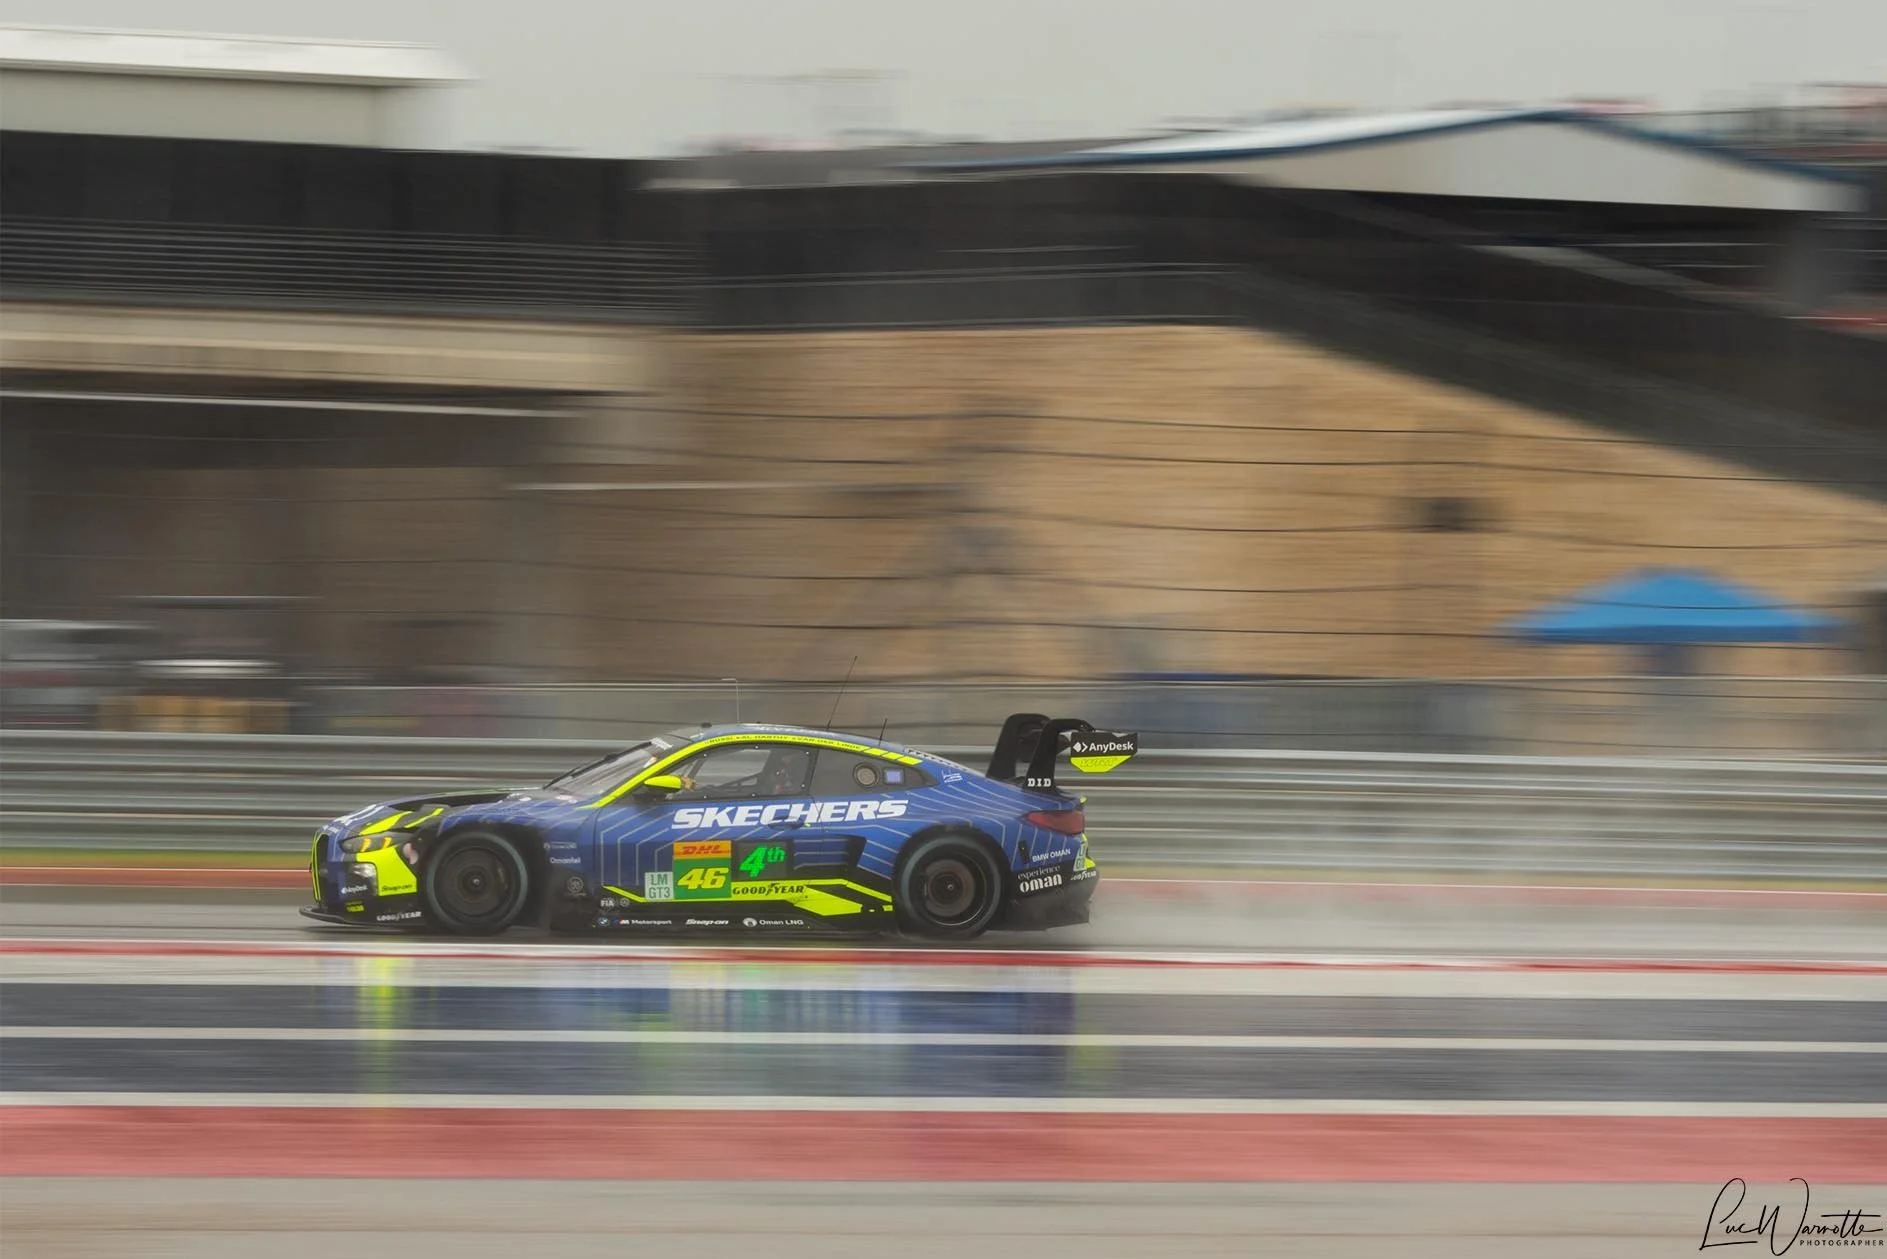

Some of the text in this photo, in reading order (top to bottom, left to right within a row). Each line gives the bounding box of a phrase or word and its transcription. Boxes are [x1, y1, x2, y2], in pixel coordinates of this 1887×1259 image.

[1089, 741, 1134, 753] AnyDesk
[1027, 778, 1052, 787] DID
[671, 800, 909, 829] SKECHERS
[681, 845, 723, 855] DHL
[1032, 852, 1049, 862] BMW
[1050, 848, 1071, 859] OMAN
[739, 845, 786, 878] 4th
[650, 874, 668, 885] LM
[677, 867, 729, 890] 46
[1019, 874, 1063, 893] oman
[648, 887, 671, 899] GT3
[733, 883, 804, 896] GOODYEAR
